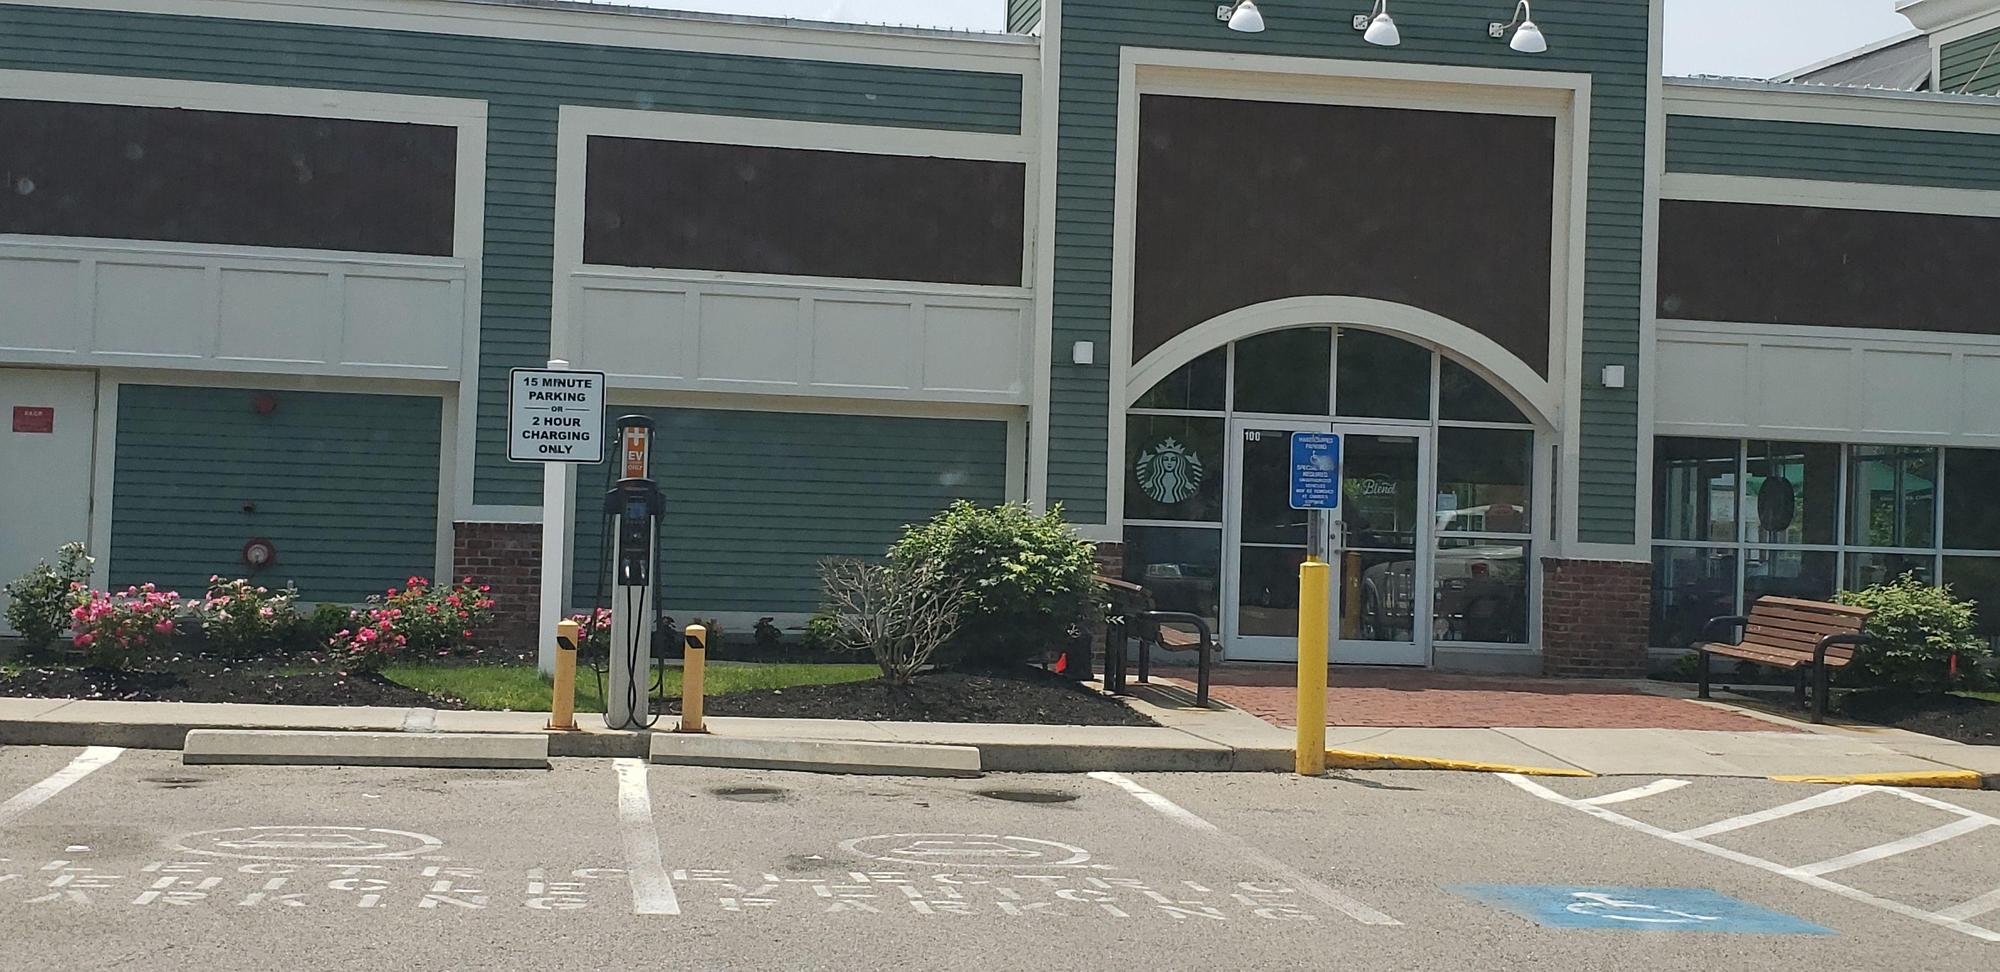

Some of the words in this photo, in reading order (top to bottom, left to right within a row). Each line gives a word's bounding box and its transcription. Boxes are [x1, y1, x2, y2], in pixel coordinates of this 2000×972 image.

[523, 377, 538, 387] 15
[542, 378, 592, 389] MINUTE
[529, 391, 586, 402] PARKING
[532, 416, 540, 426] 2
[544, 417, 581, 427] HOUR
[522, 430, 590, 441] CHARGING
[1245, 431, 1261, 442] 100
[539, 444, 573, 454] ONLY
[628, 450, 644, 461] EV
[1362, 479, 1397, 496] Blend
[0, 858, 627, 879] LECTRIC
